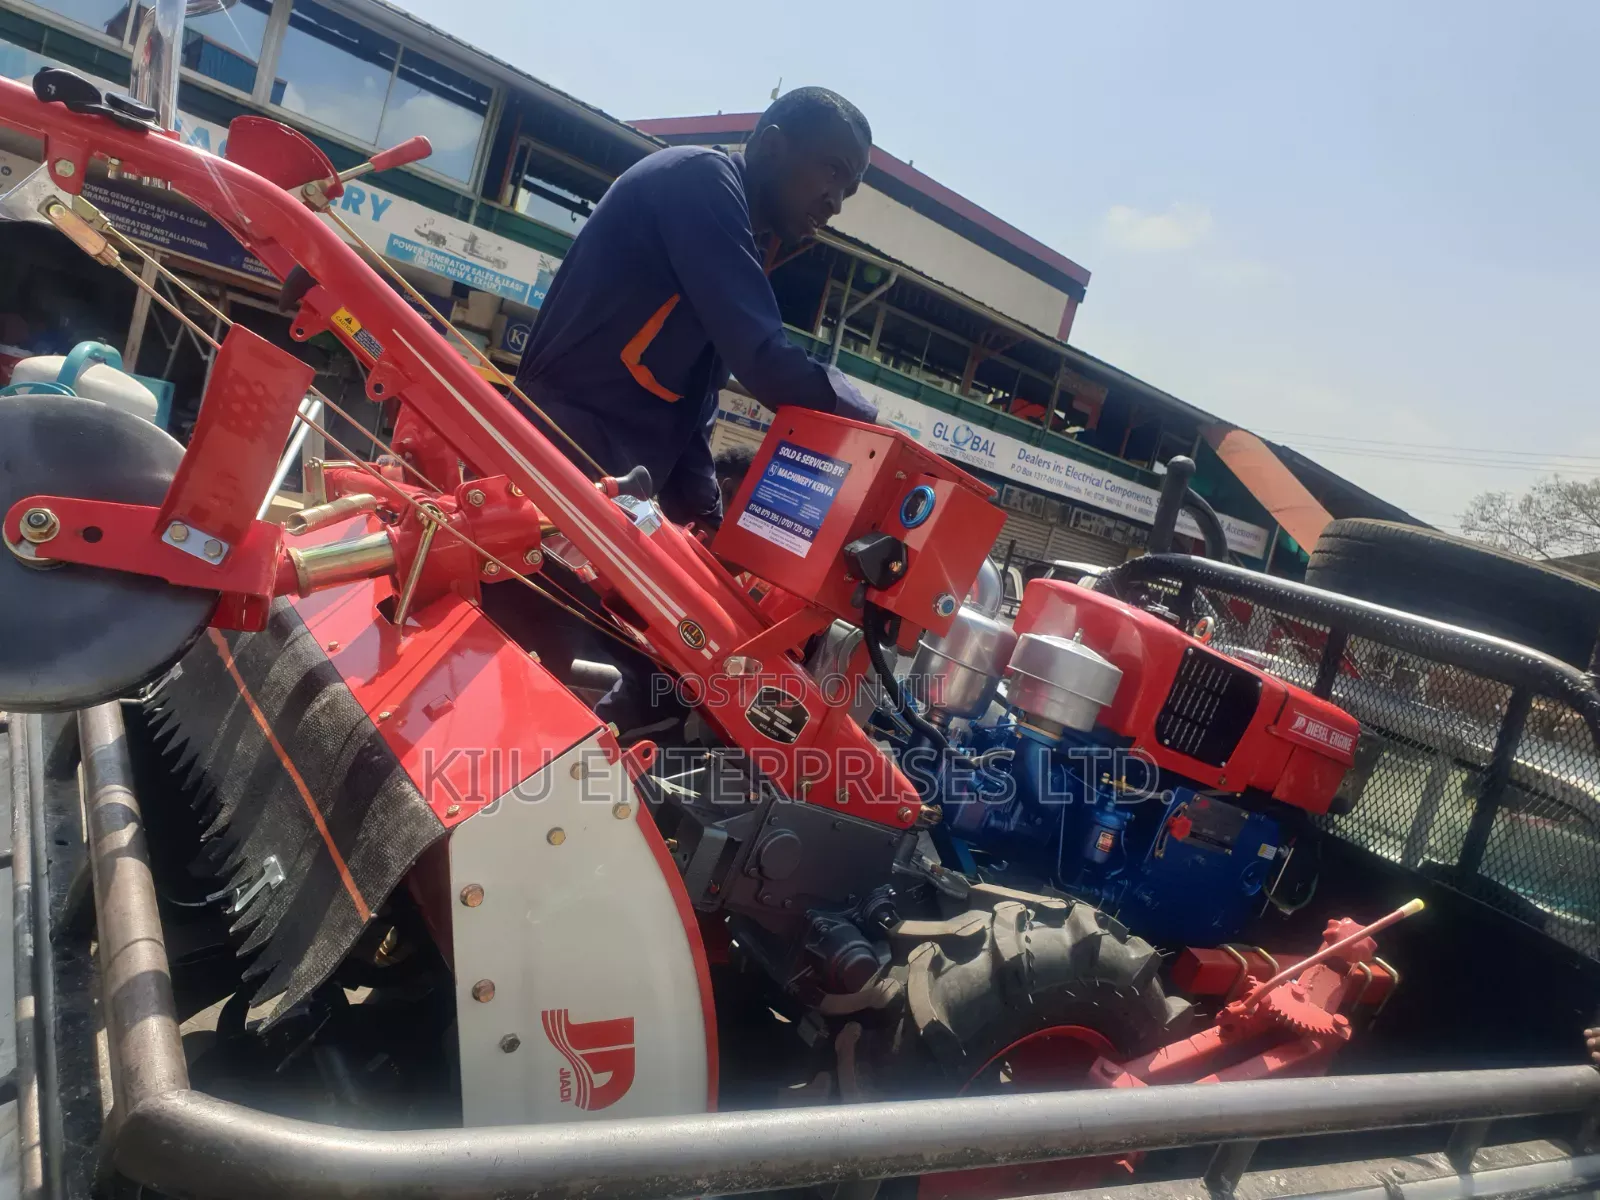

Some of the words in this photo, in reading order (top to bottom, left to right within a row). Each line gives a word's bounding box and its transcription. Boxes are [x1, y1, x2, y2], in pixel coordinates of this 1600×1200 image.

[84, 183, 109, 198] OWER
[110, 191, 156, 211] GENERATOR
[186, 214, 207, 229] LEASE
[115, 199, 130, 212] NEW
[105, 212, 151, 231] GENERATOR
[139, 229, 170, 245] REPAIRS
[447, 265, 466, 279] NEW
[502, 277, 525, 293] LEASE
[779, 446, 797, 459] SOLD
[801, 454, 832, 473] SERVICED
[832, 466, 845, 477] BY:
[959, 450, 984, 467] TRADERS
[777, 467, 812, 488] MACHINERY
[812, 480, 834, 497] KENYA
[1017, 447, 1051, 469] Dealers
[1052, 461, 1063, 475] in:
[1065, 464, 1103, 488] Electrical
[1104, 480, 1153, 508] Components,
[1305, 721, 1329, 741] DIESEL
[1329, 731, 1353, 751] ENGINE
[559, 1067, 572, 1103] JIADI
